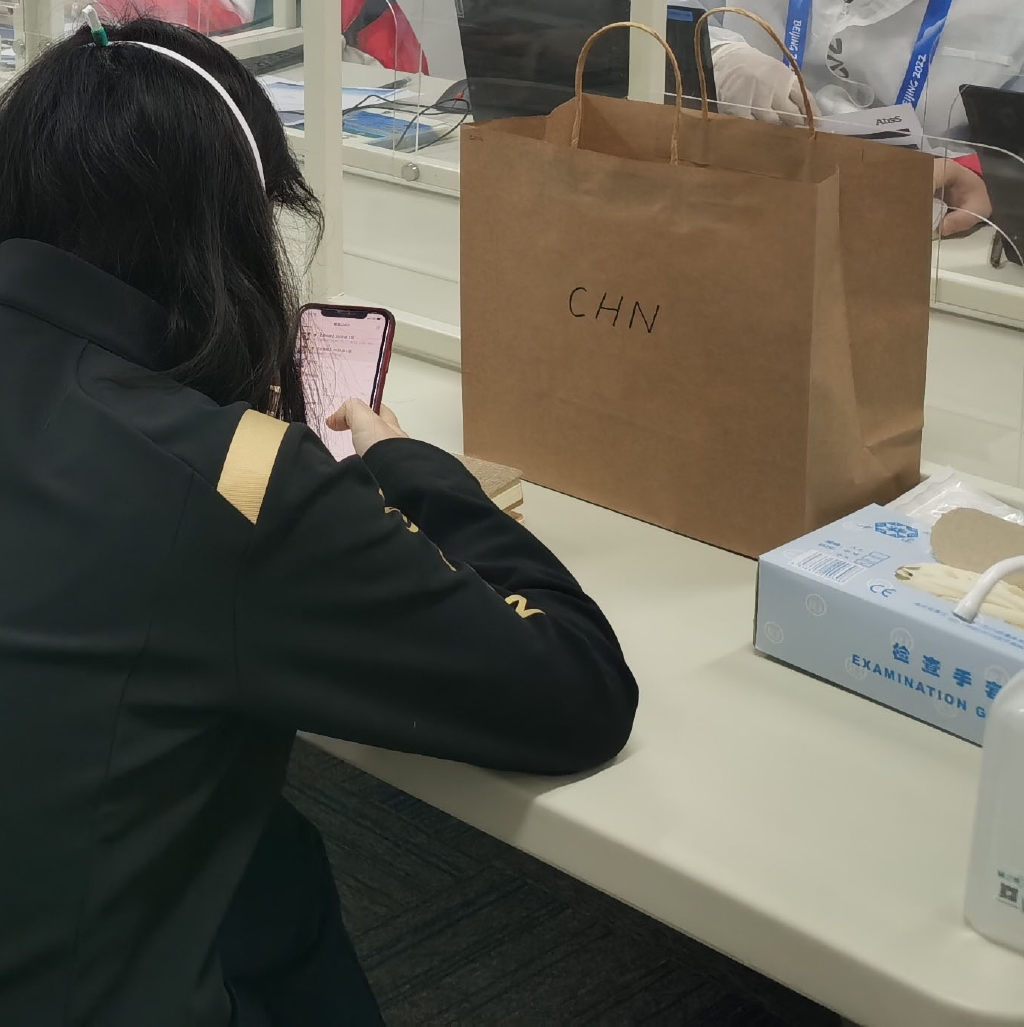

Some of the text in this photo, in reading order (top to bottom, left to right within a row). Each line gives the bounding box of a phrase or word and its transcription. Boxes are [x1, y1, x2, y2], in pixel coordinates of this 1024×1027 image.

[788, 19, 802, 51] BEIJING
[902, 54, 927, 105] EIJING 2022
[568, 286, 660, 334] CHN
[852, 653, 967, 712] EXAMINATION
